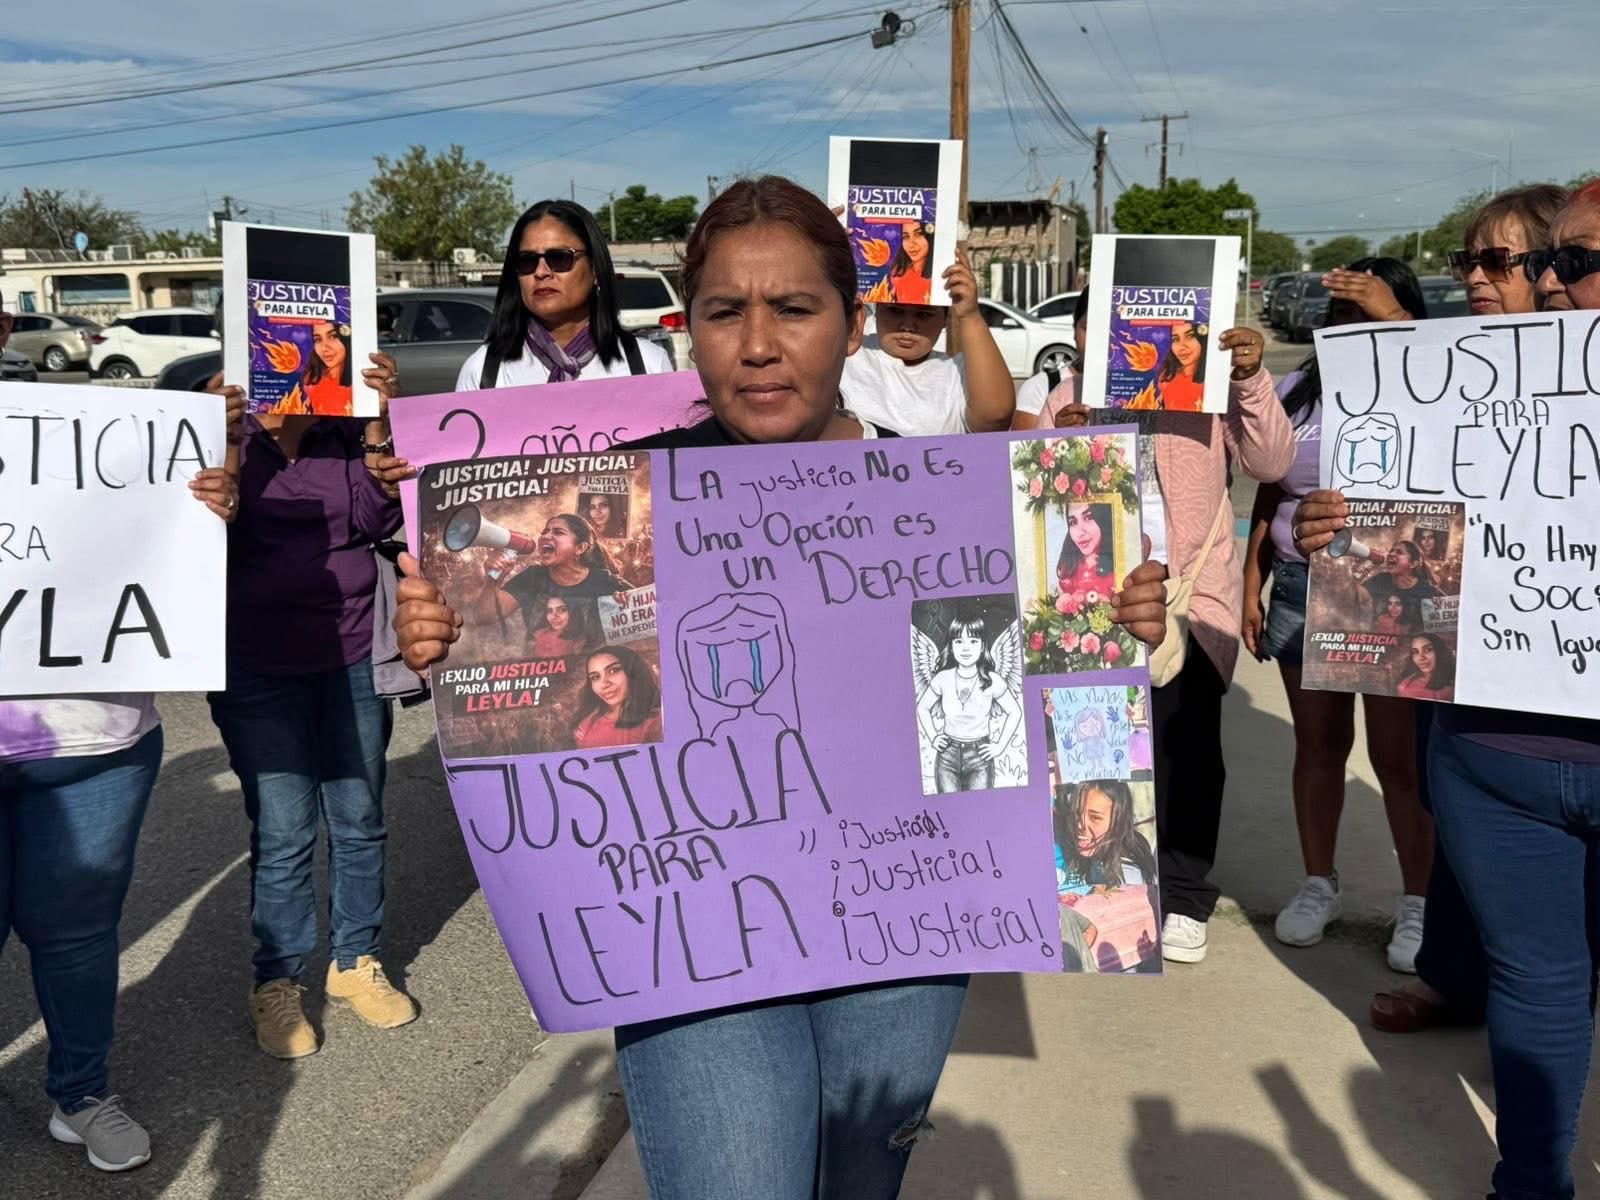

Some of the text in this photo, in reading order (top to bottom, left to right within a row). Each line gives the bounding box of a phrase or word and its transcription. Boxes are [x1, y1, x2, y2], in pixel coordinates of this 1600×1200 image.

[851, 188, 925, 205] JUSTICIA
[862, 206, 917, 217] PARA LEYLA
[252, 281, 338, 304] JUSTICIA
[1115, 288, 1198, 305] JUSTICIA
[264, 303, 329, 316] PARA LEYLA
[1126, 307, 1189, 317] PARA LEYLA
[1463, 398, 1550, 427] PARA
[0, 416, 208, 490] TICIA
[923, 448, 964, 476] Es
[1406, 423, 1600, 501] LEYLA
[431, 454, 636, 489] JUSTICIA! JUSTICIA!
[583, 475, 628, 487] JUSTICIA
[436, 478, 549, 511] JUSTICIA!
[602, 485, 630, 493] LEYLA
[1389, 502, 1457, 515] JUSTICIA!
[1344, 515, 1397, 528] STICIA!
[675, 502, 937, 562] Una Opción es
[807, 546, 1013, 606] DERECHO
[611, 607, 656, 628] NO ERA
[607, 629, 620, 641] UN
[1345, 633, 1398, 646] JUSTICIA
[1480, 612, 1531, 653] Sin
[1320, 642, 1385, 654] PARA MI HIJA
[1326, 650, 1380, 664] LEYLA!
[440, 660, 567, 685] ¡EXIJO JUSTICIA
[455, 676, 550, 696] PARA MI HIJA
[466, 689, 541, 713] LEYLA!
[599, 834, 727, 895] PARA
